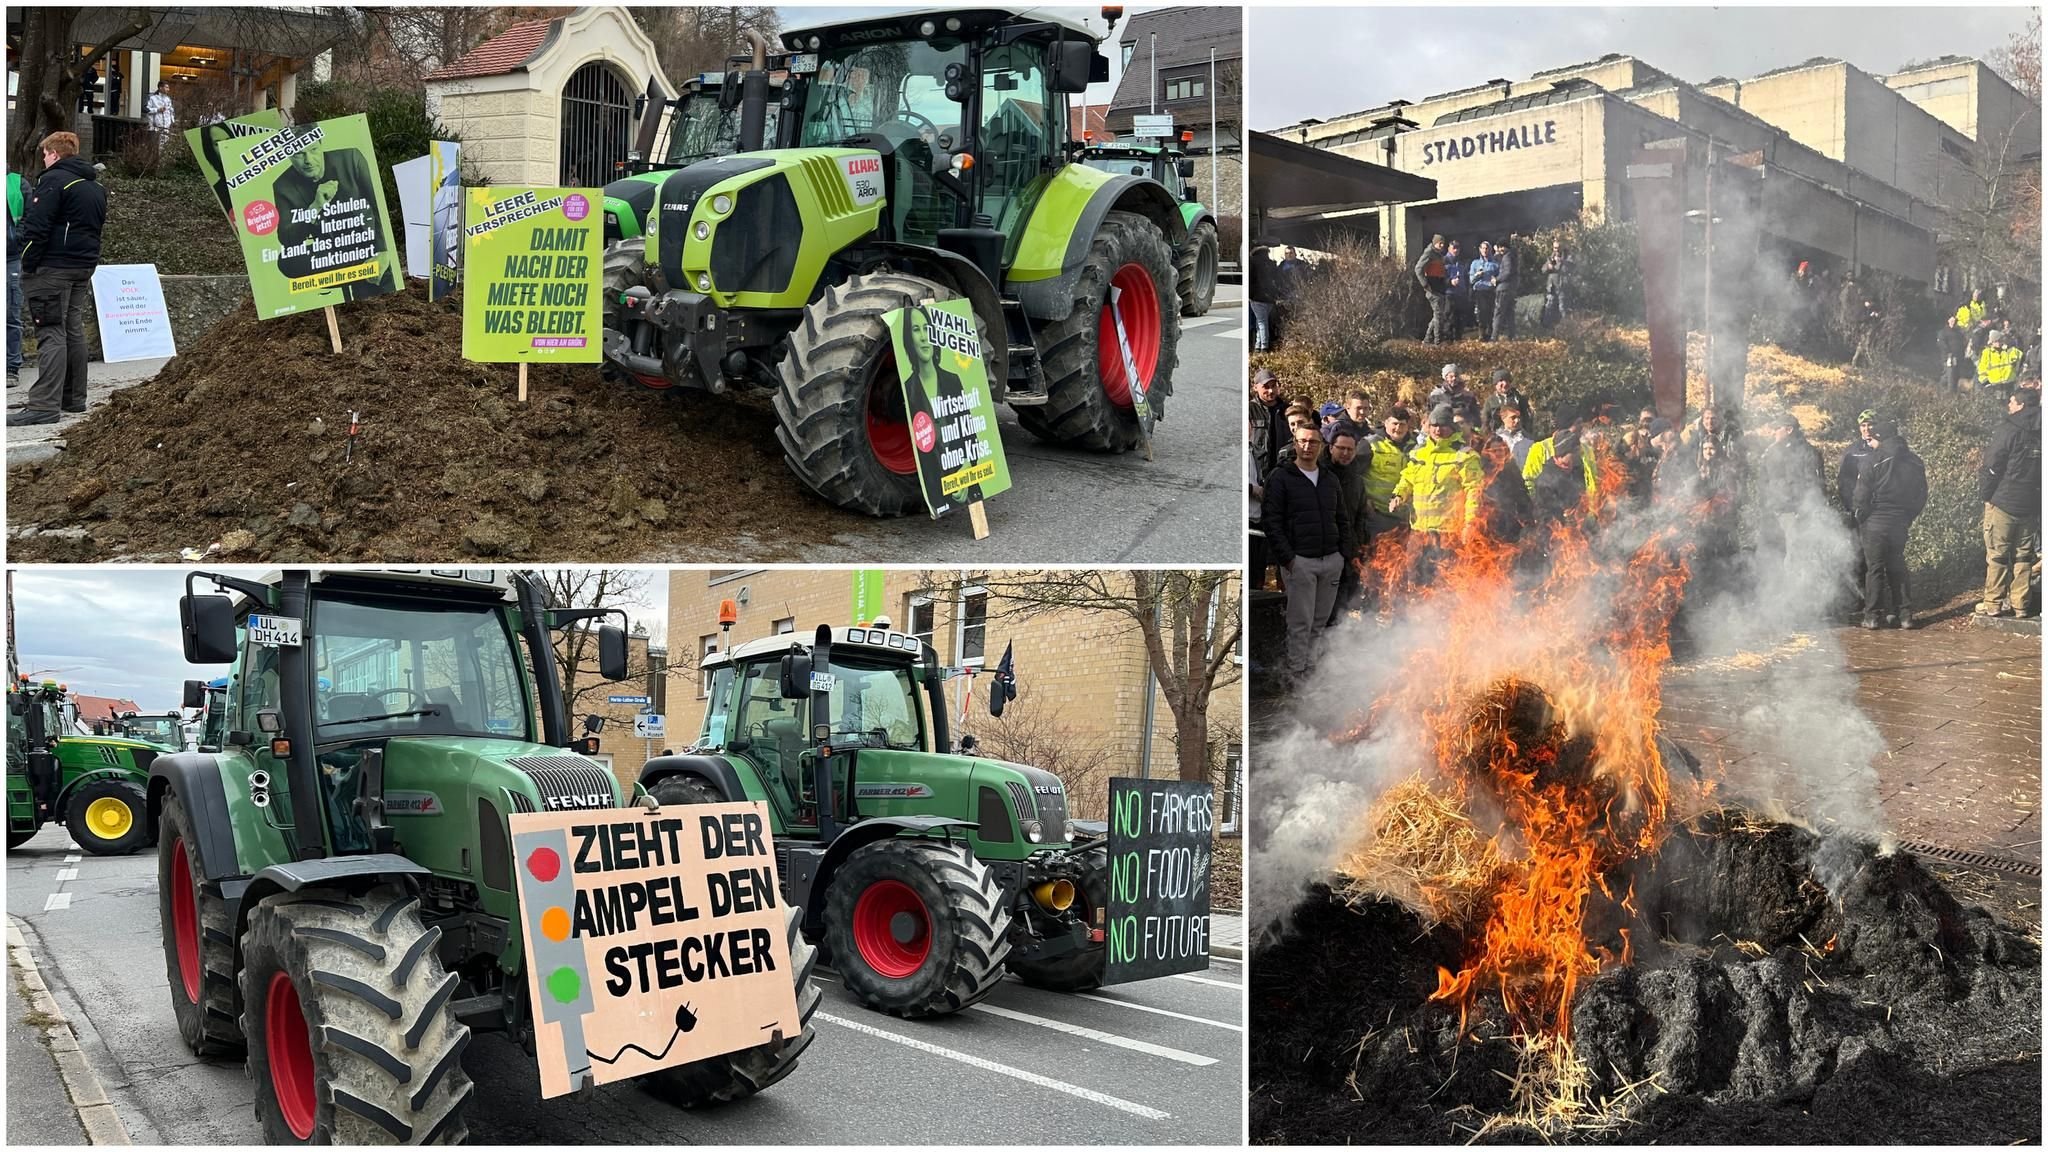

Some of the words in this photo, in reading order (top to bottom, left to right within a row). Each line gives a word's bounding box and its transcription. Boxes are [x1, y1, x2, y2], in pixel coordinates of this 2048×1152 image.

[840, 26, 902, 42] ARION
[240, 128, 294, 165] LEERE
[1423, 120, 1556, 166] STADTHALLE
[226, 128, 324, 189] VERSPRECHEN!
[848, 159, 880, 174] CLAAS
[856, 180, 870, 190] 530
[858, 187, 878, 198] ARION
[291, 208, 320, 224] Züge,
[322, 198, 370, 217] Schulen,
[466, 196, 562, 237] VERSPRECHEN!
[484, 192, 536, 218] LEERE
[663, 203, 688, 212] CLAAS
[320, 213, 364, 234] Internet
[262, 248, 278, 263] Ein
[280, 242, 310, 260] Land,
[312, 236, 332, 253] das
[334, 227, 374, 248] einfach
[530, 228, 590, 251] DAMIT
[311, 244, 378, 270] funktioniert.
[504, 256, 552, 278] NACH
[555, 256, 588, 278] DER
[292, 278, 318, 291] Bereit,
[318, 274, 334, 286] weil
[335, 272, 347, 282] Ihr
[348, 270, 357, 280] es
[358, 265, 376, 277] seid.
[487, 283, 538, 306] MIETE
[540, 283, 588, 306] NOCH
[484, 310, 524, 334] WAS
[526, 310, 586, 334] BLEIBT.
[930, 308, 976, 336] WAHL-
[928, 325, 980, 358] LÜGEN!
[931, 388, 981, 419] Wirtschaft
[941, 418, 960, 444] und
[960, 414, 986, 437] Klima
[941, 447, 964, 470] ohne
[965, 440, 992, 462] Krise.
[260, 618, 277, 630] UL
[547, 794, 610, 808] FENDT
[1034, 786, 1061, 794] FENDT
[386, 799, 409, 809] FARMER
[410, 799, 420, 809] 412
[1114, 790, 1142, 838] NO
[1150, 792, 1214, 834] FARMERS
[572, 819, 682, 874] ZIEHT
[700, 814, 767, 859] DER
[1112, 852, 1140, 904] NO
[1146, 848, 1191, 900] FOOD
[572, 876, 699, 938] AMPEL
[707, 866, 776, 918] DEN
[1110, 915, 1137, 964] NO
[1144, 916, 1209, 960] FUTURE
[604, 928, 776, 997] STECKER
